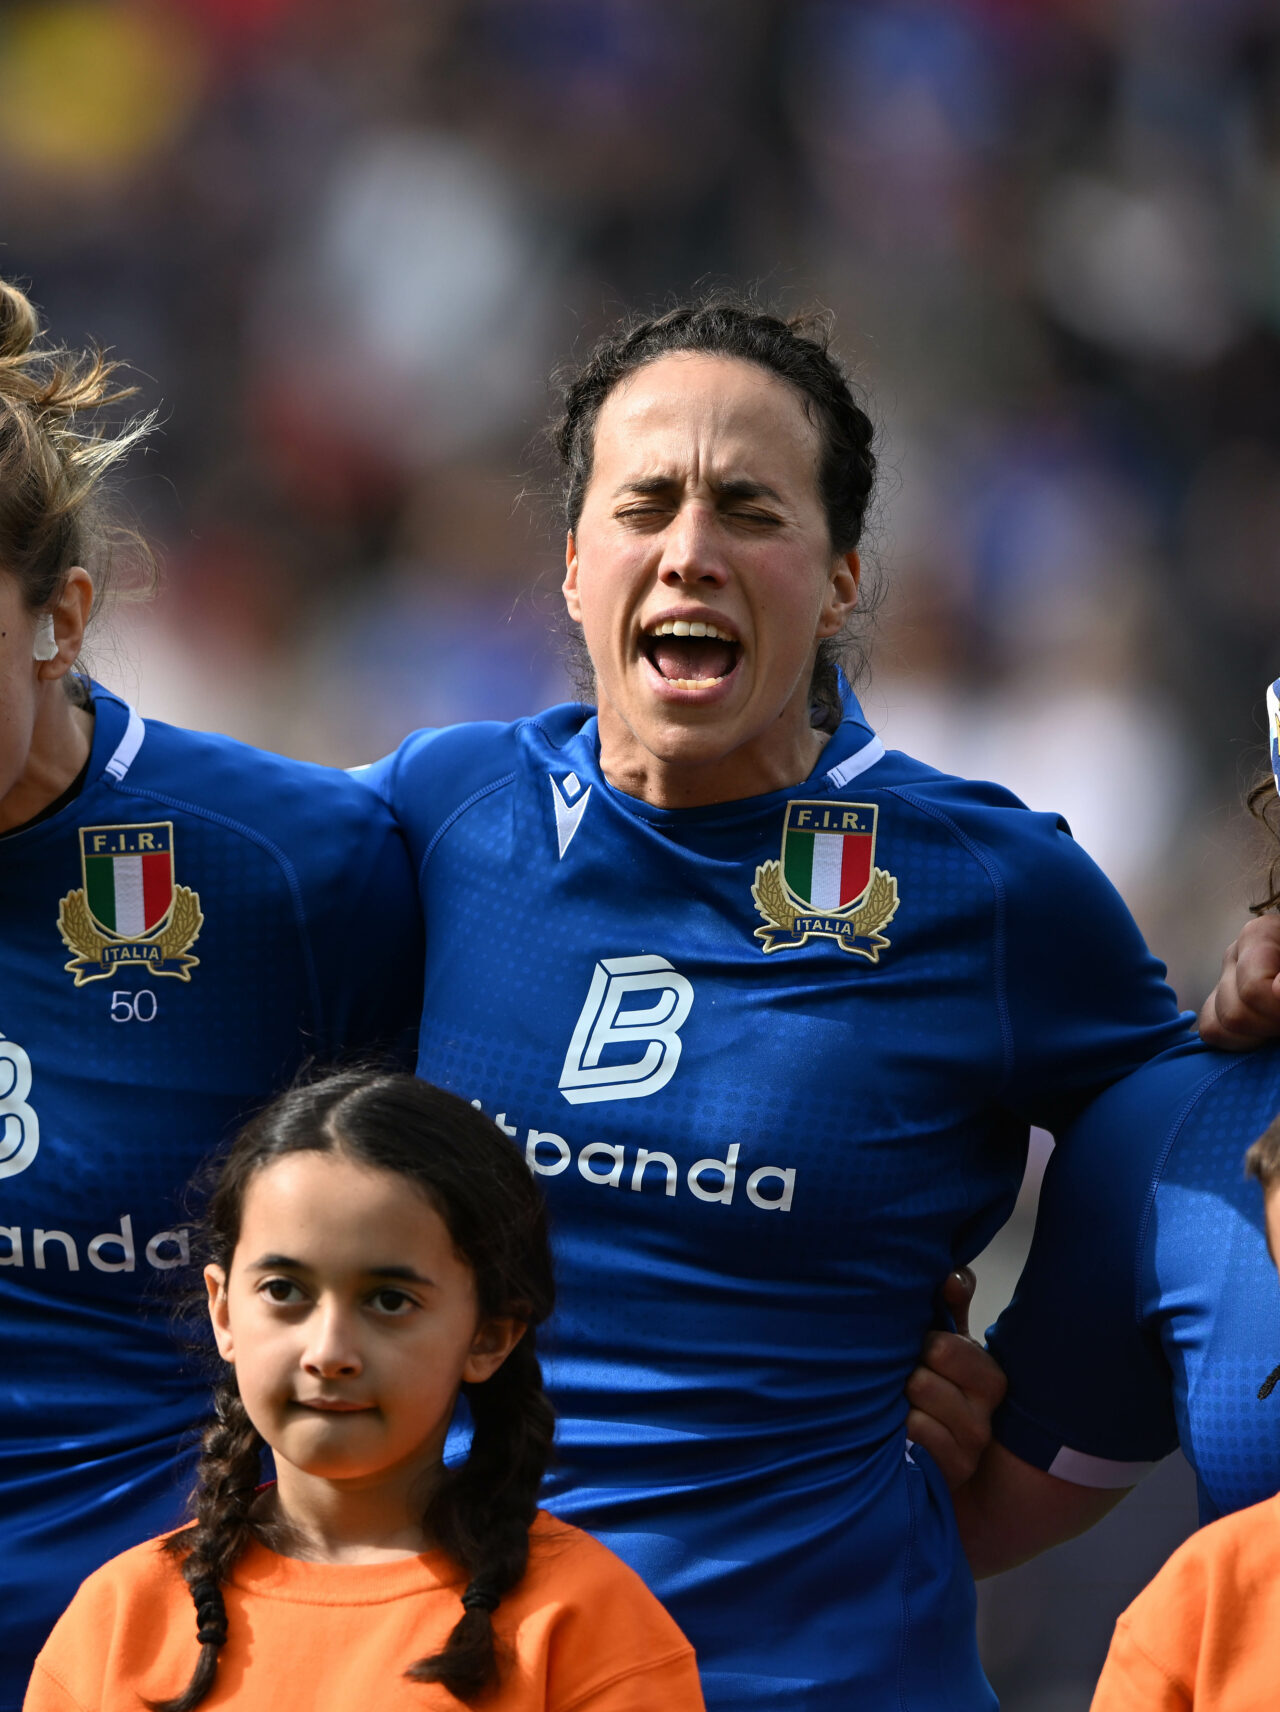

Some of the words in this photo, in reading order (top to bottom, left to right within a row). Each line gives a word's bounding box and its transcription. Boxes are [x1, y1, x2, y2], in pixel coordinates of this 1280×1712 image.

[797, 810, 866, 830] F.I.R.
[94, 833, 163, 852] F.I.R.
[796, 919, 852, 936] ITALIA
[104, 947, 160, 962] ITALIA
[110, 989, 158, 1023] 50
[470, 1098, 797, 1212] panda
